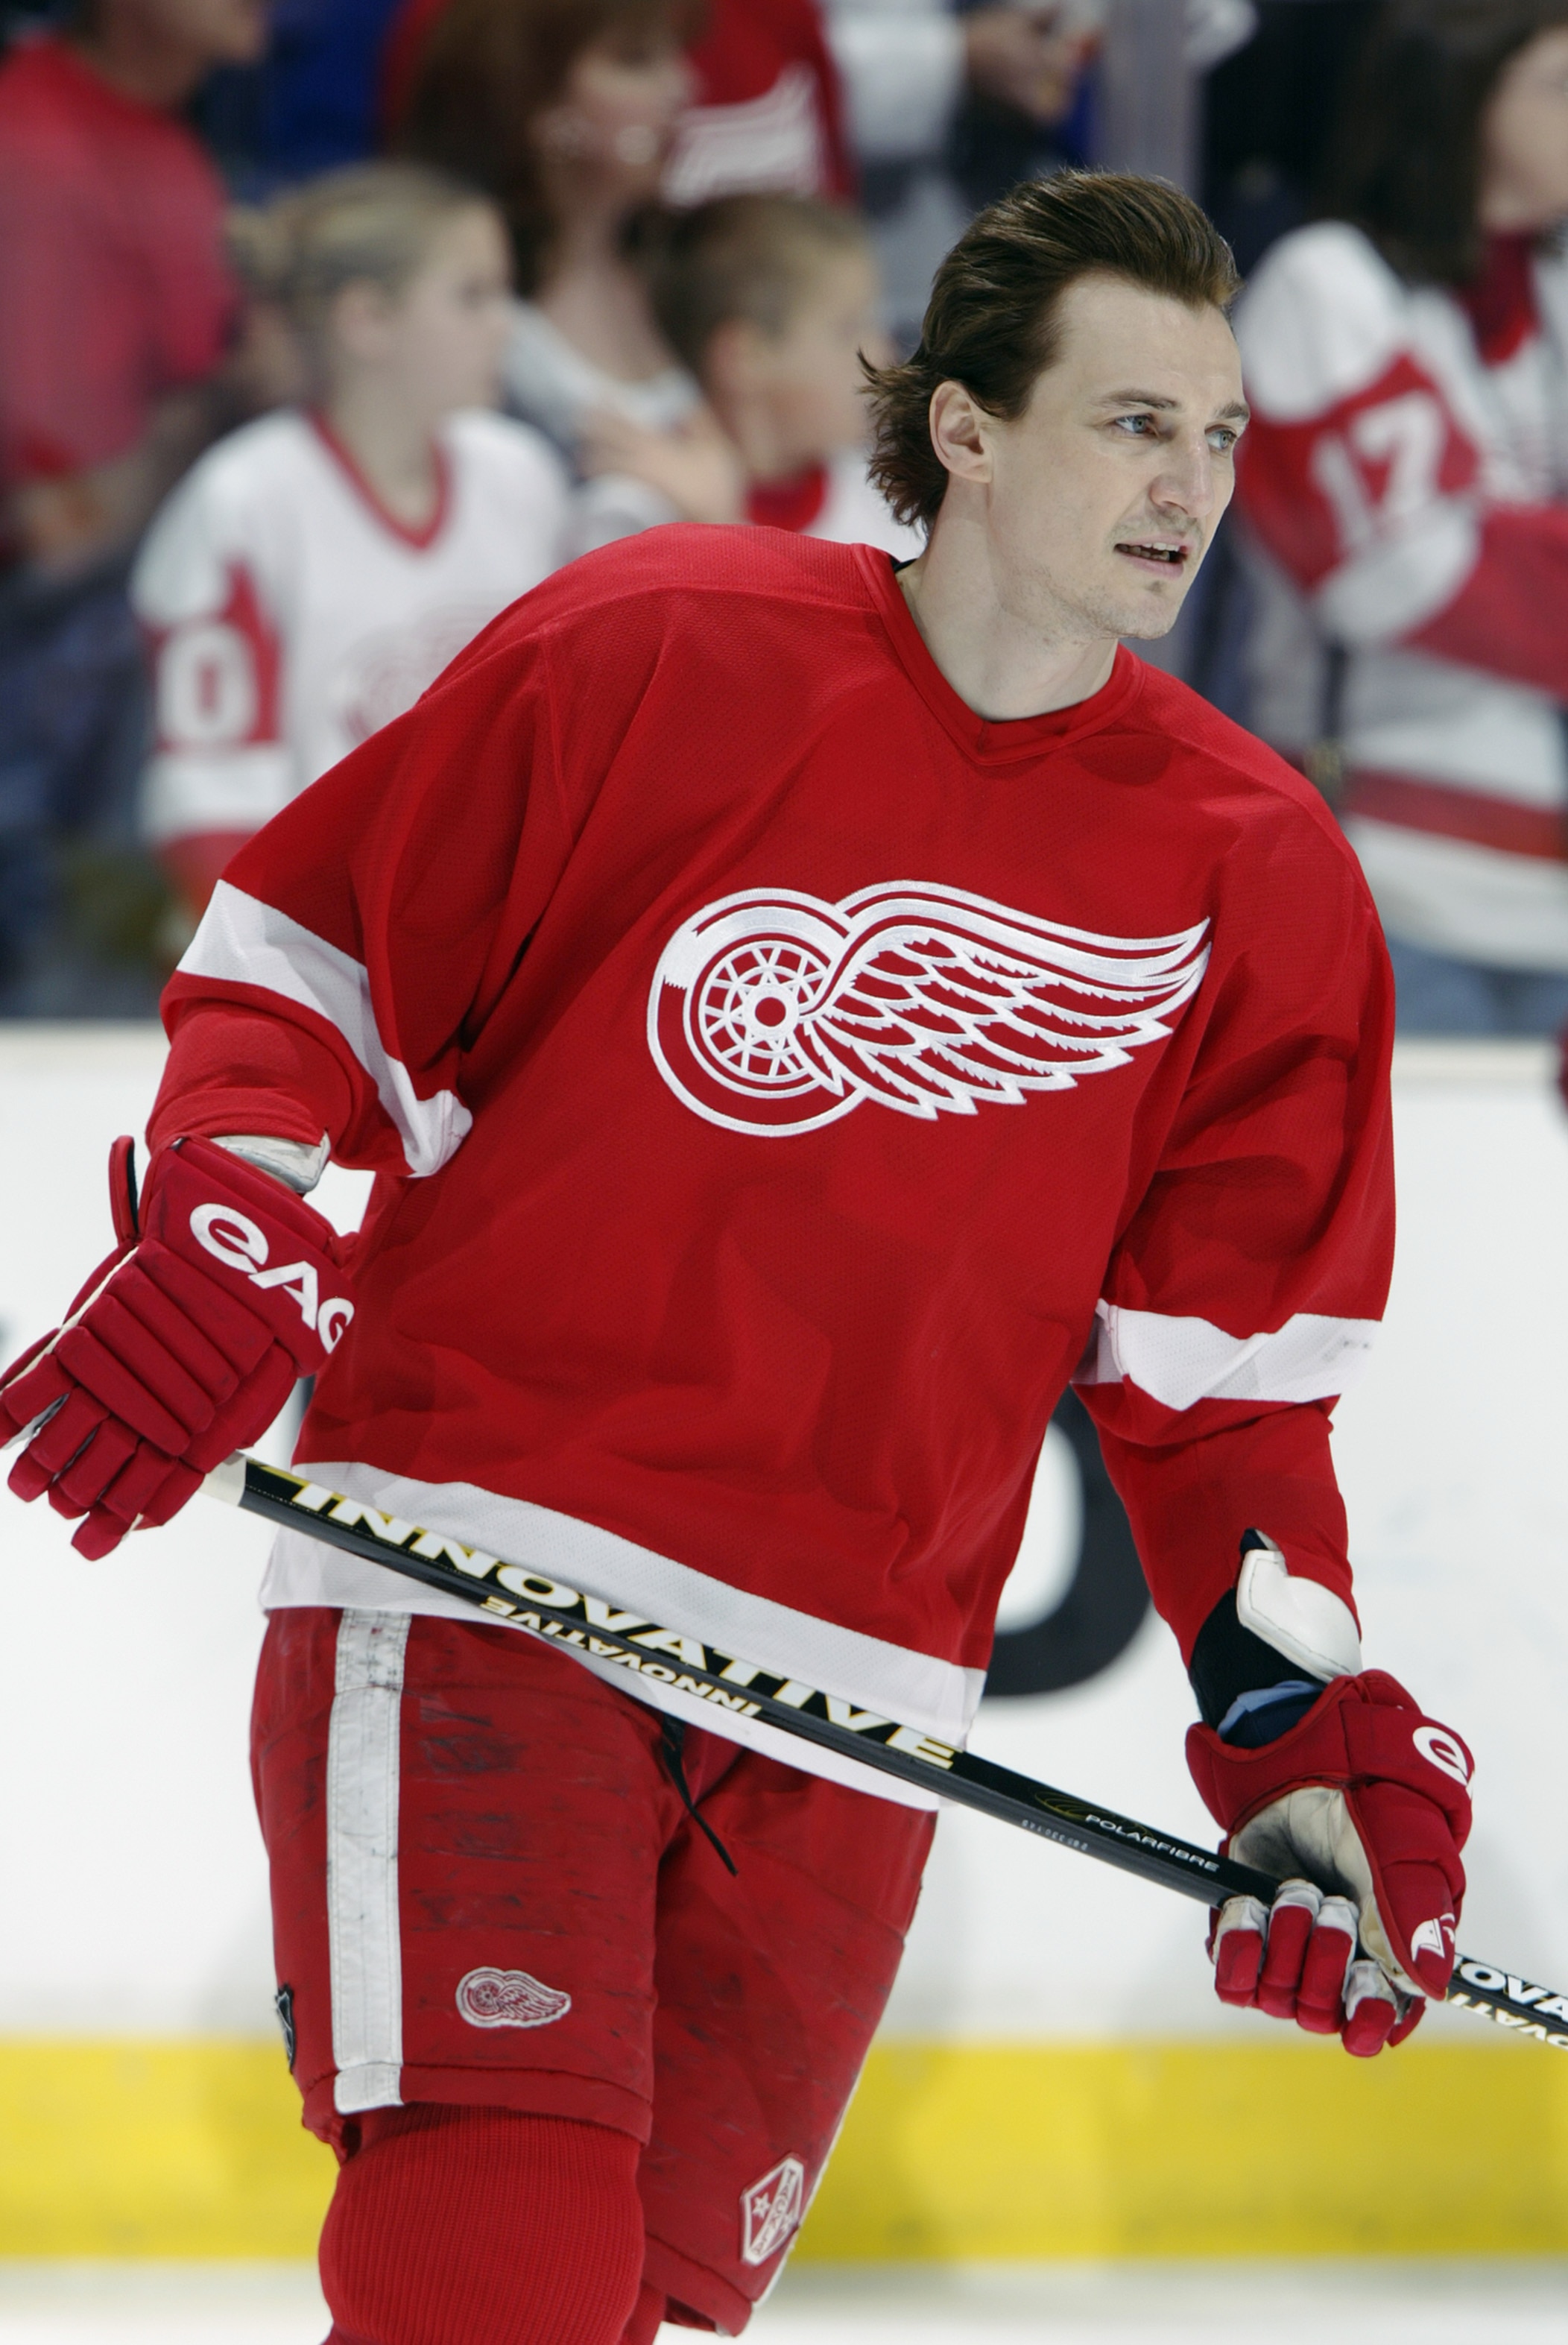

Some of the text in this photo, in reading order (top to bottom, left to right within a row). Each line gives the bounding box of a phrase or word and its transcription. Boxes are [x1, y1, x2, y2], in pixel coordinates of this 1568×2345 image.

[264, 1465, 964, 1770] INNOVATIVE
[479, 1595, 762, 1717] INNOVATIVE
[1085, 1814, 1221, 1872] POLARFIBRE
[1454, 1952, 1568, 2024] OVA
